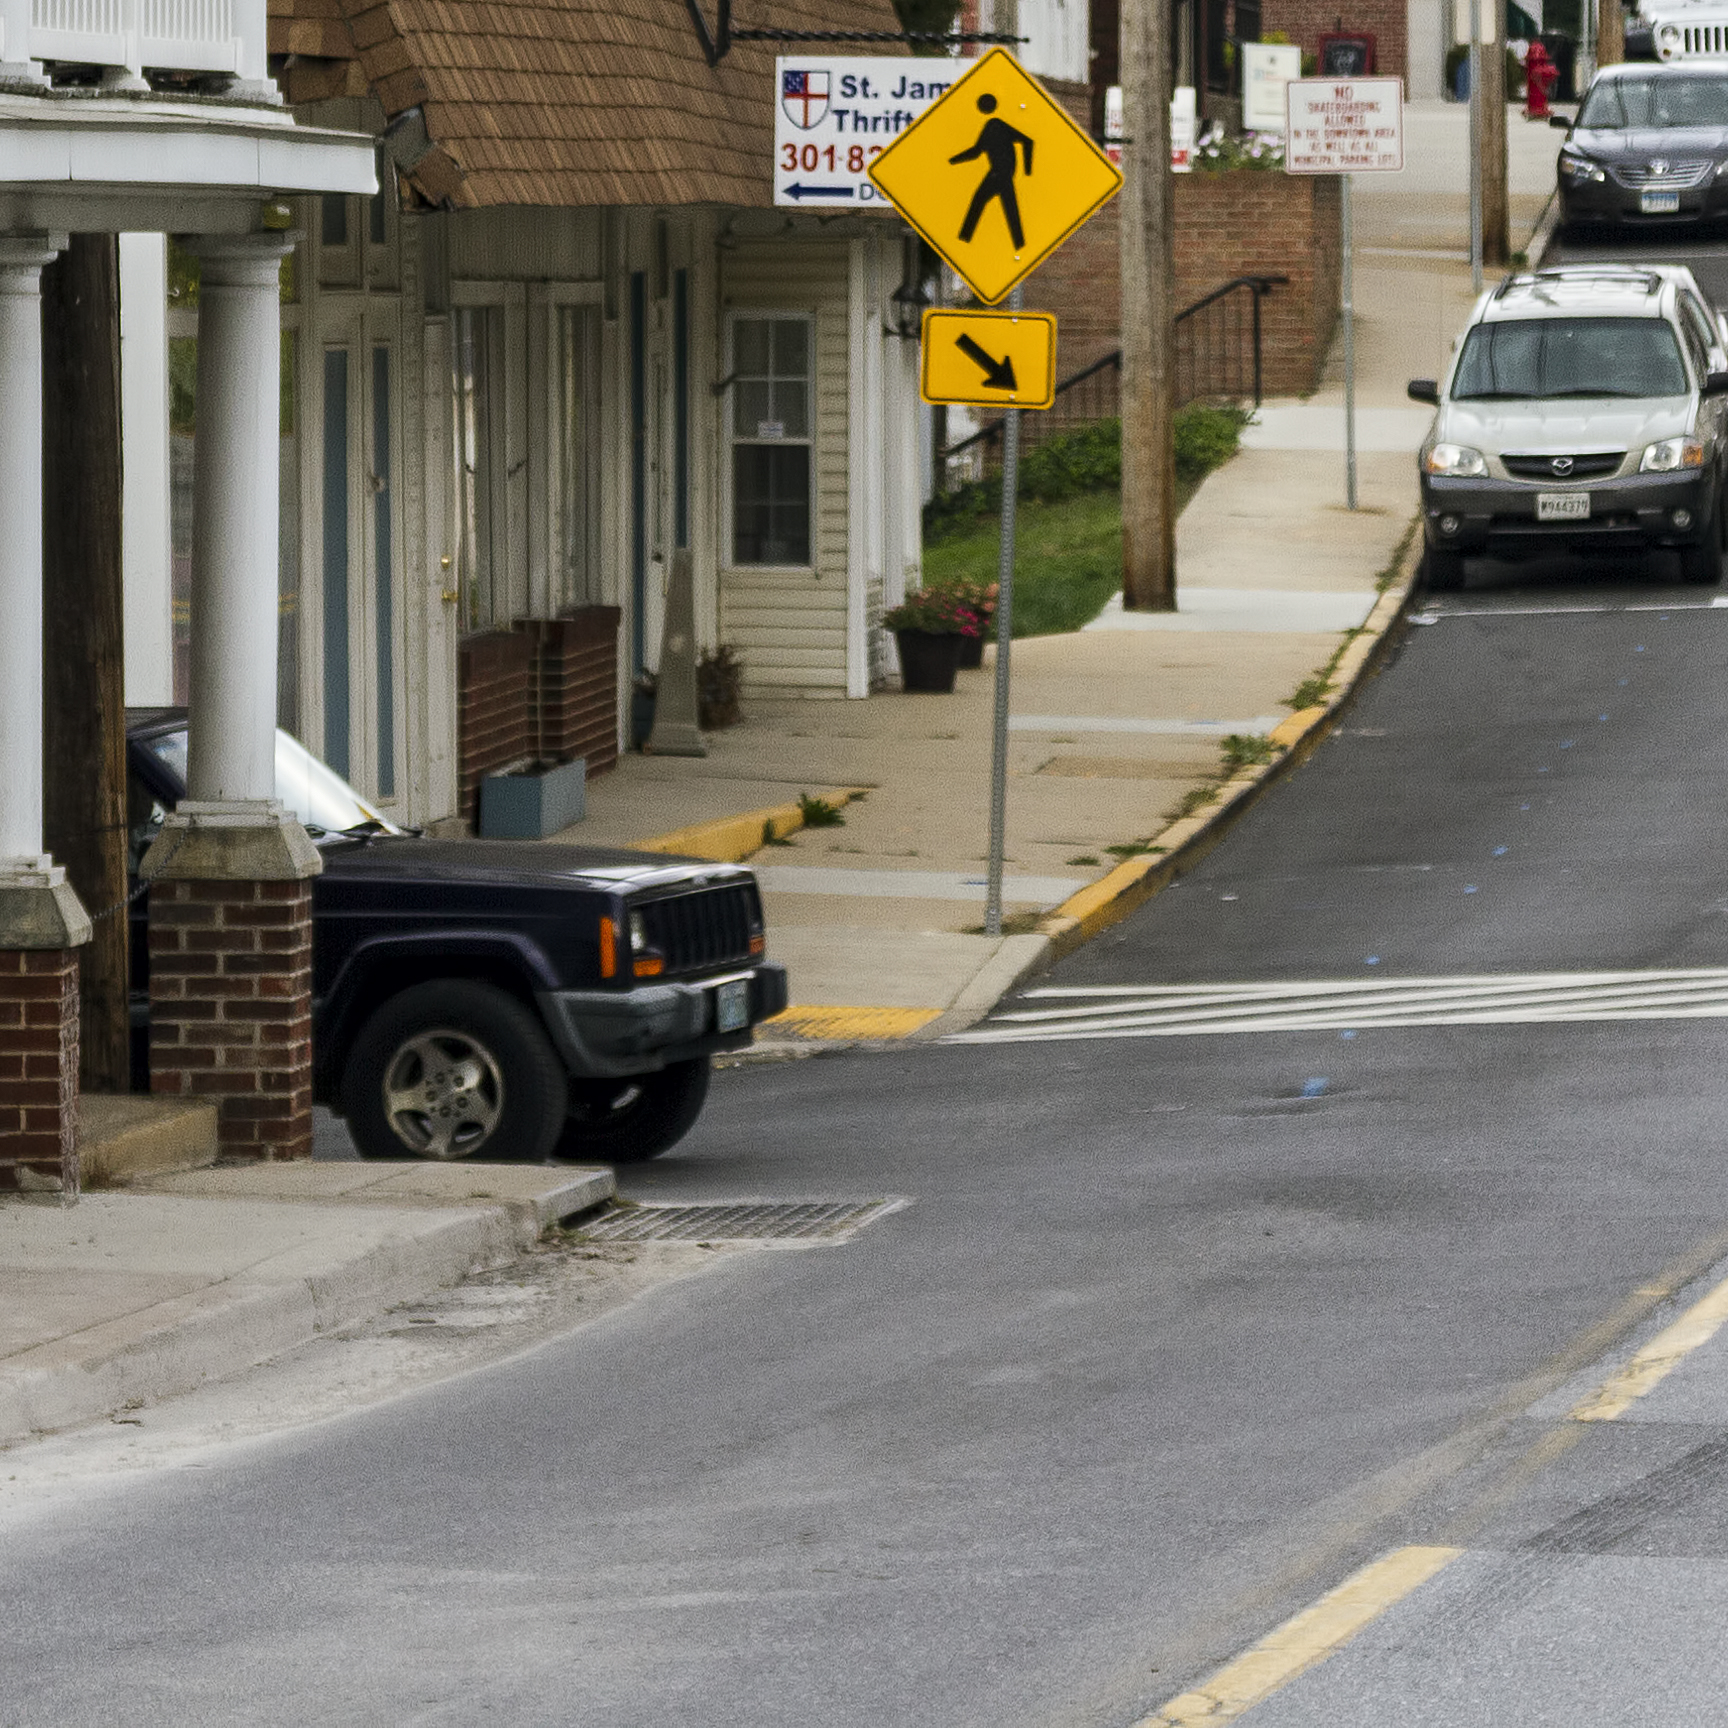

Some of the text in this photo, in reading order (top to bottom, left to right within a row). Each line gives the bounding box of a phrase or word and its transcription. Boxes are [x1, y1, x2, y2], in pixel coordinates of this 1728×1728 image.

[840, 75, 879, 98] St.
[1334, 86, 1354, 100] NO
[831, 109, 914, 133] Thrift
[1324, 114, 1366, 127] ALLOWED
